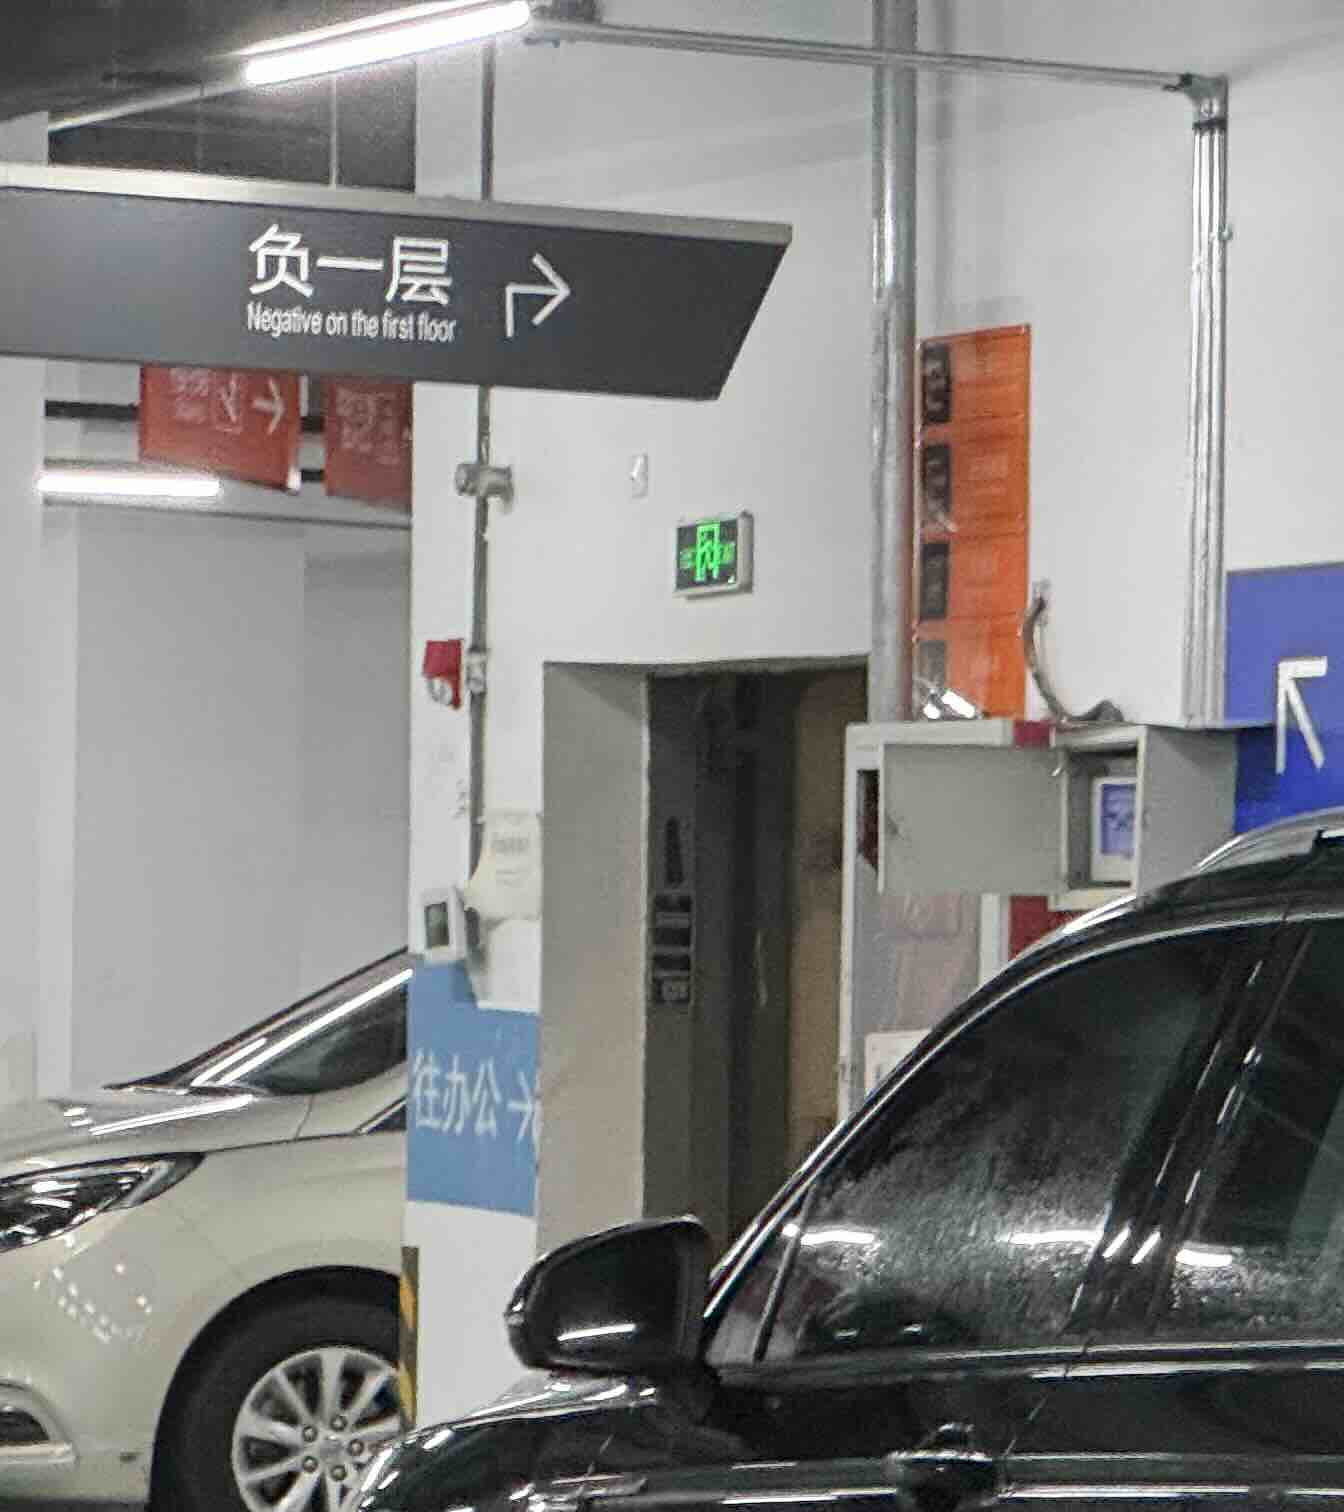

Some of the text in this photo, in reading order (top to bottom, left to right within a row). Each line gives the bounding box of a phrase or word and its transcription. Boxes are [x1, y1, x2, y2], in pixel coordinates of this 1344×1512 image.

[248, 223, 453, 306] 负一层
[247, 301, 457, 343] Negative on the first floor
